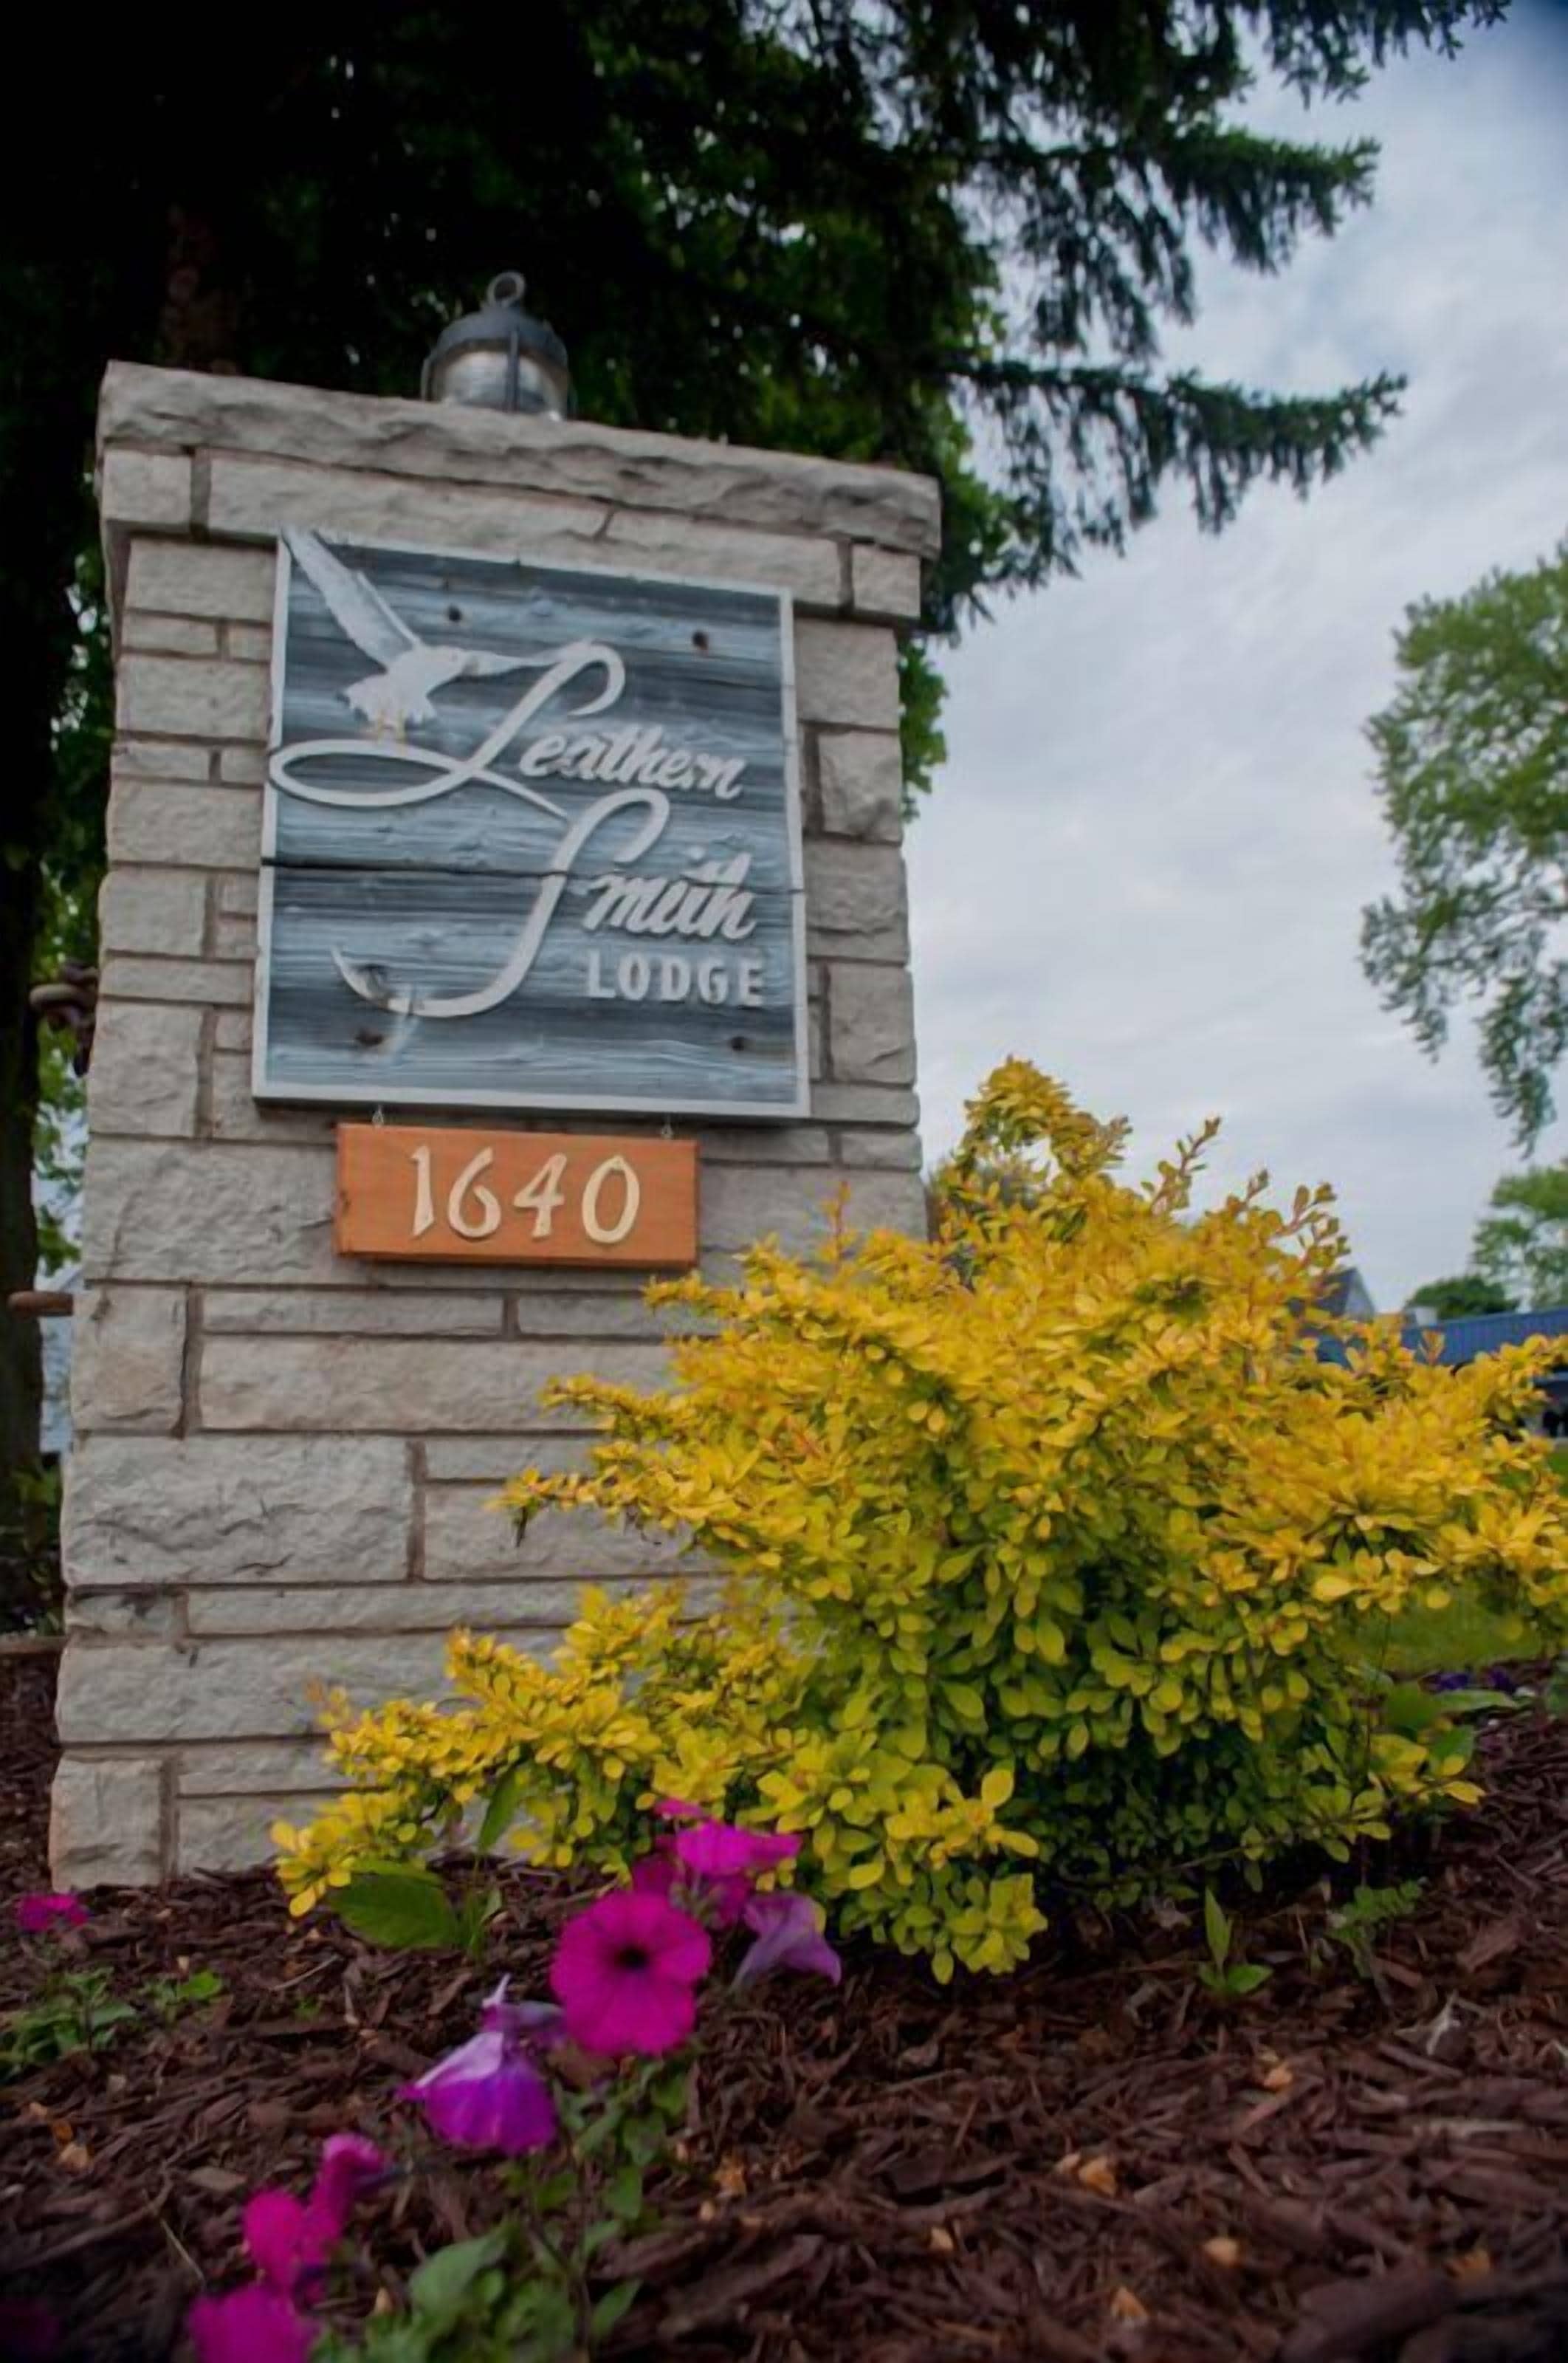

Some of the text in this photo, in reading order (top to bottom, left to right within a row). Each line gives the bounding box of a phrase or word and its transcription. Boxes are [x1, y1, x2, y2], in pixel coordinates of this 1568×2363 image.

[330, 788, 757, 1018] Smith
[588, 949, 763, 1006] LODGE
[410, 1145, 640, 1244] 1640
